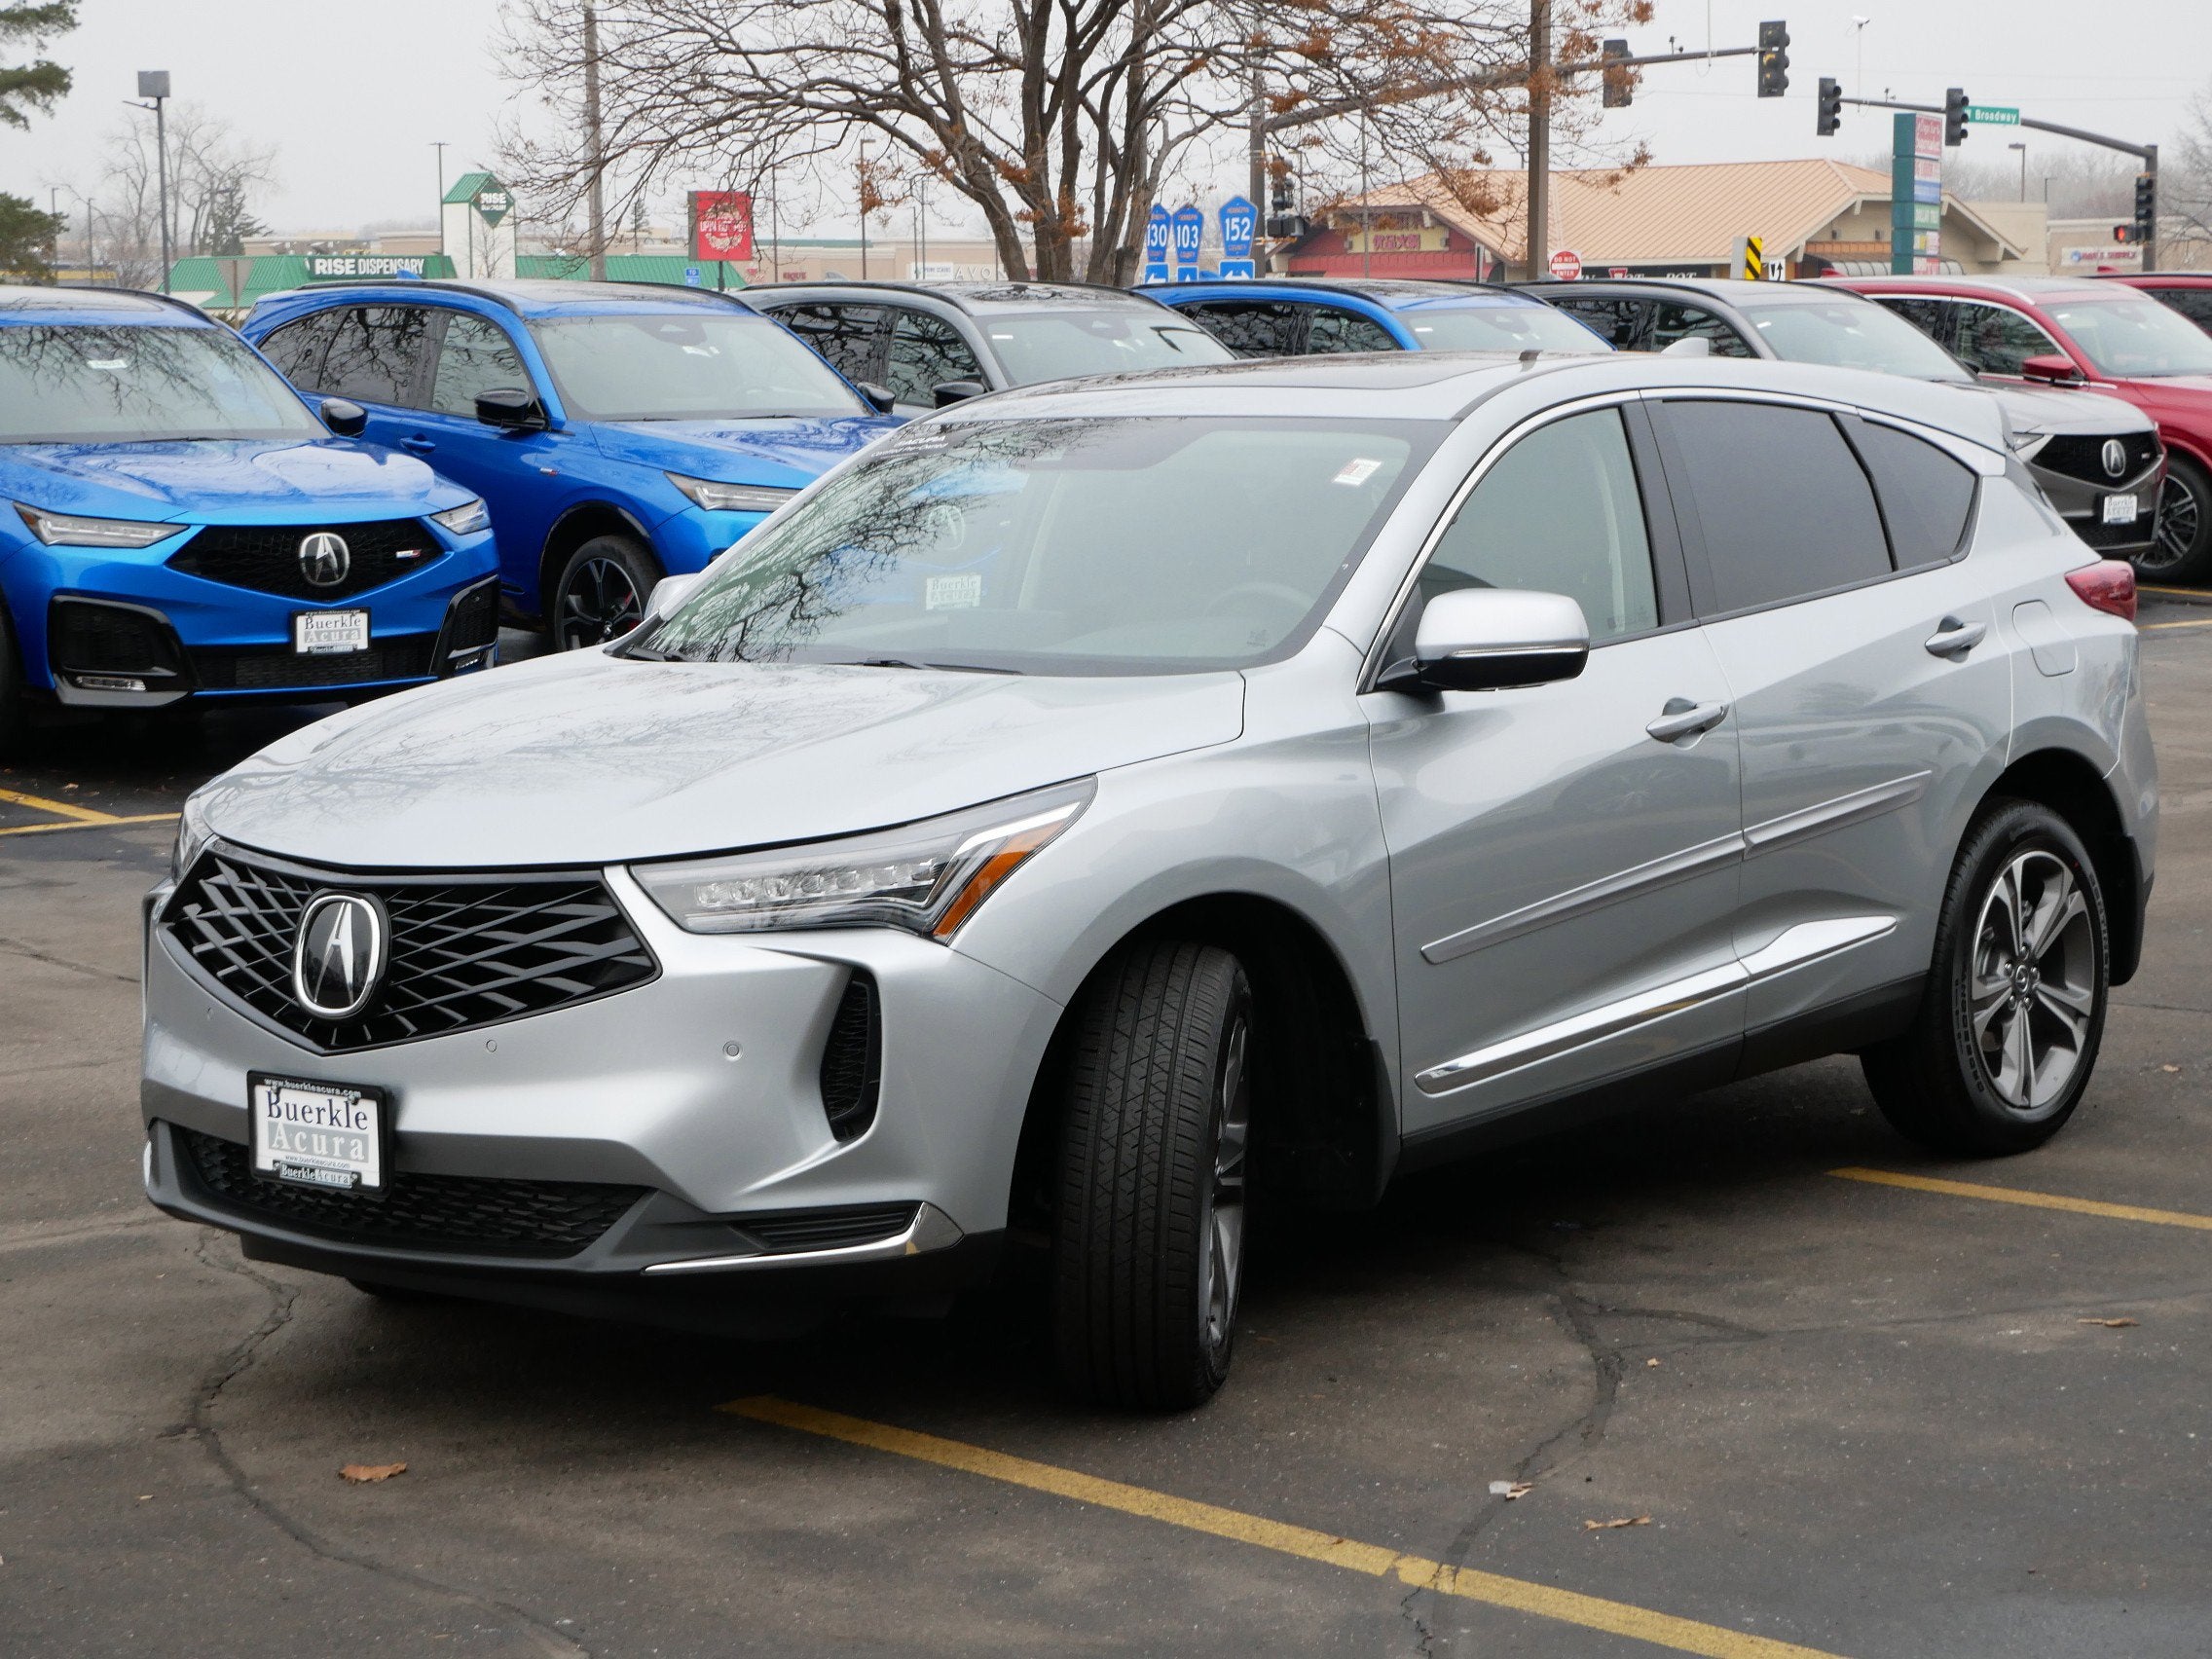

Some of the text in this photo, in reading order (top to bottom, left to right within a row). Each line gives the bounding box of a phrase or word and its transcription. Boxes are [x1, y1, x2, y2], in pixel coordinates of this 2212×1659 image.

[1974, 108, 2016, 125] Broadway
[480, 193, 506, 203] RISE
[1147, 223, 1167, 247] 130
[1176, 224, 1198, 248] 103
[1225, 216, 1251, 241] 152
[314, 258, 425, 275] RISE DISPENSARY
[305, 614, 361, 630] Buerkle
[306, 629, 360, 644] Acura
[264, 1077, 362, 1098] www.buerkleacura.com
[266, 1089, 368, 1130] Buerkle
[271, 1121, 365, 1161] Acura
[281, 1164, 316, 1181] Buerkle
